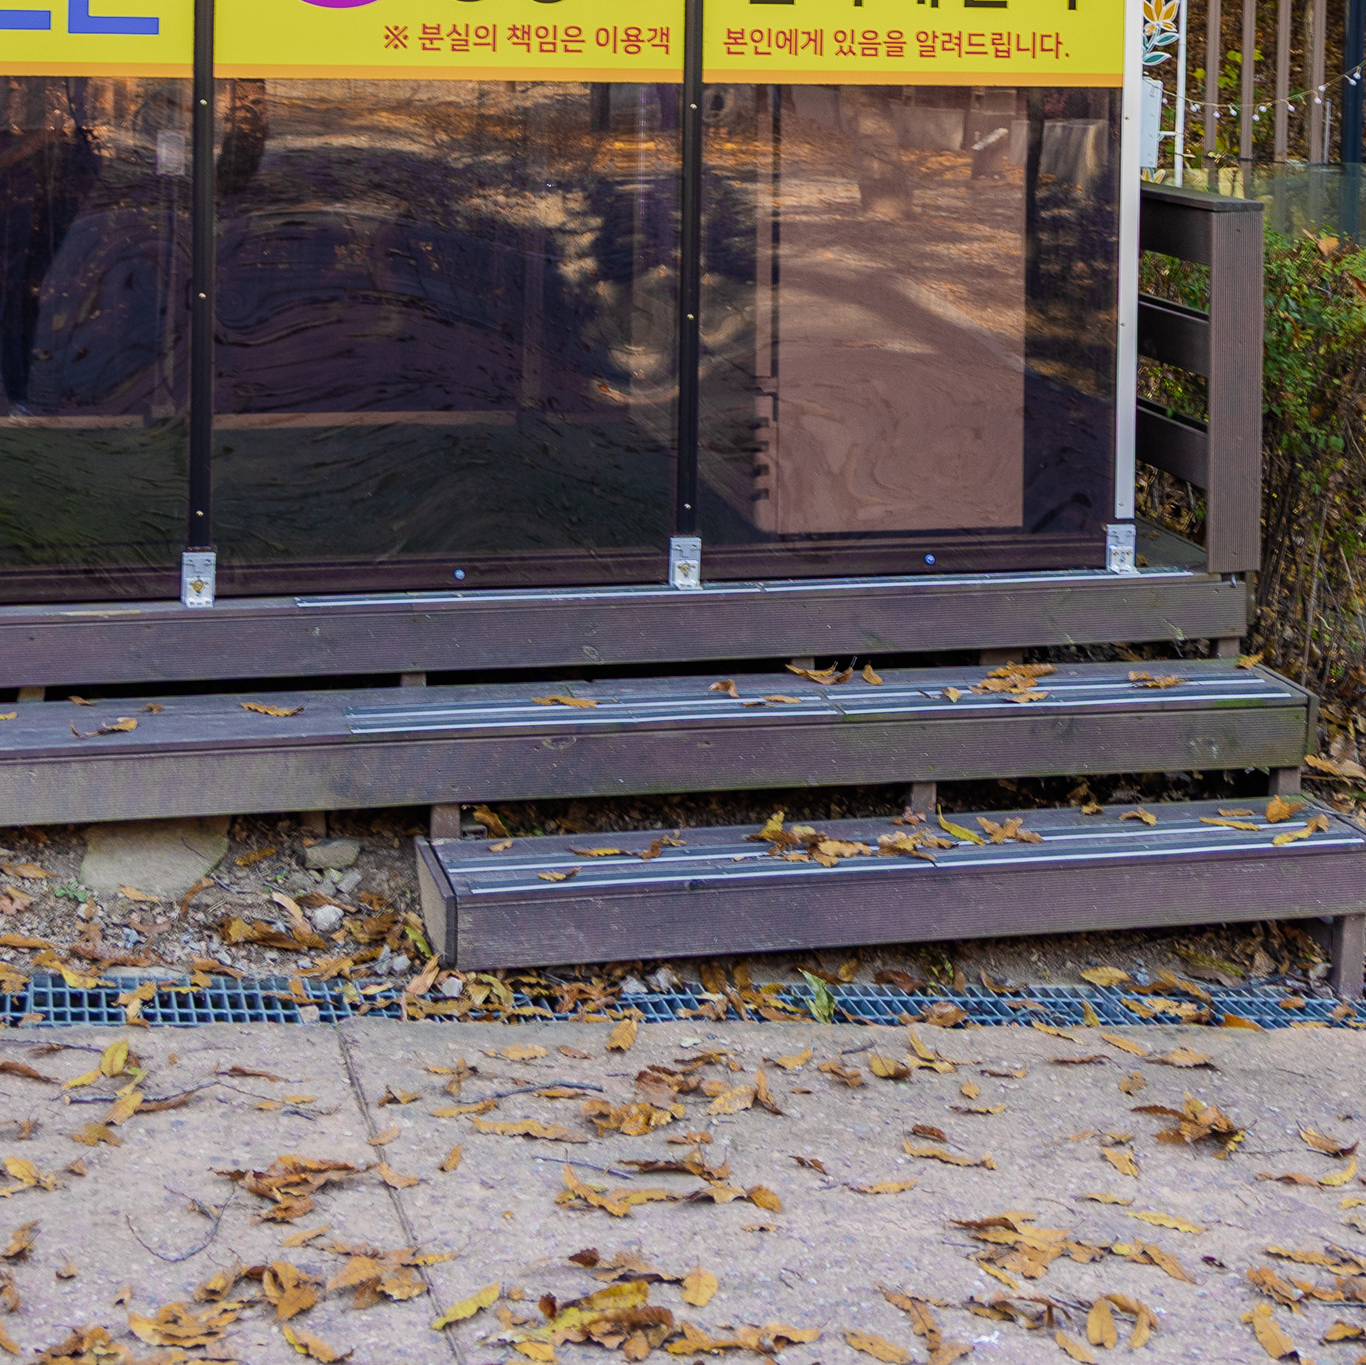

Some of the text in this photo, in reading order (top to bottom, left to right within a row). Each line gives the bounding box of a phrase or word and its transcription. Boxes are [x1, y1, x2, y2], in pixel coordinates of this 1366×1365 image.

[418, 23, 497, 53] 분실의
[506, 24, 586, 54] 책임은
[595, 25, 670, 56] 이용객
[723, 27, 824, 57] 본인에게
[833, 28, 907, 58] 있음을
[915, 30, 1070, 60] 알려드립니다.
